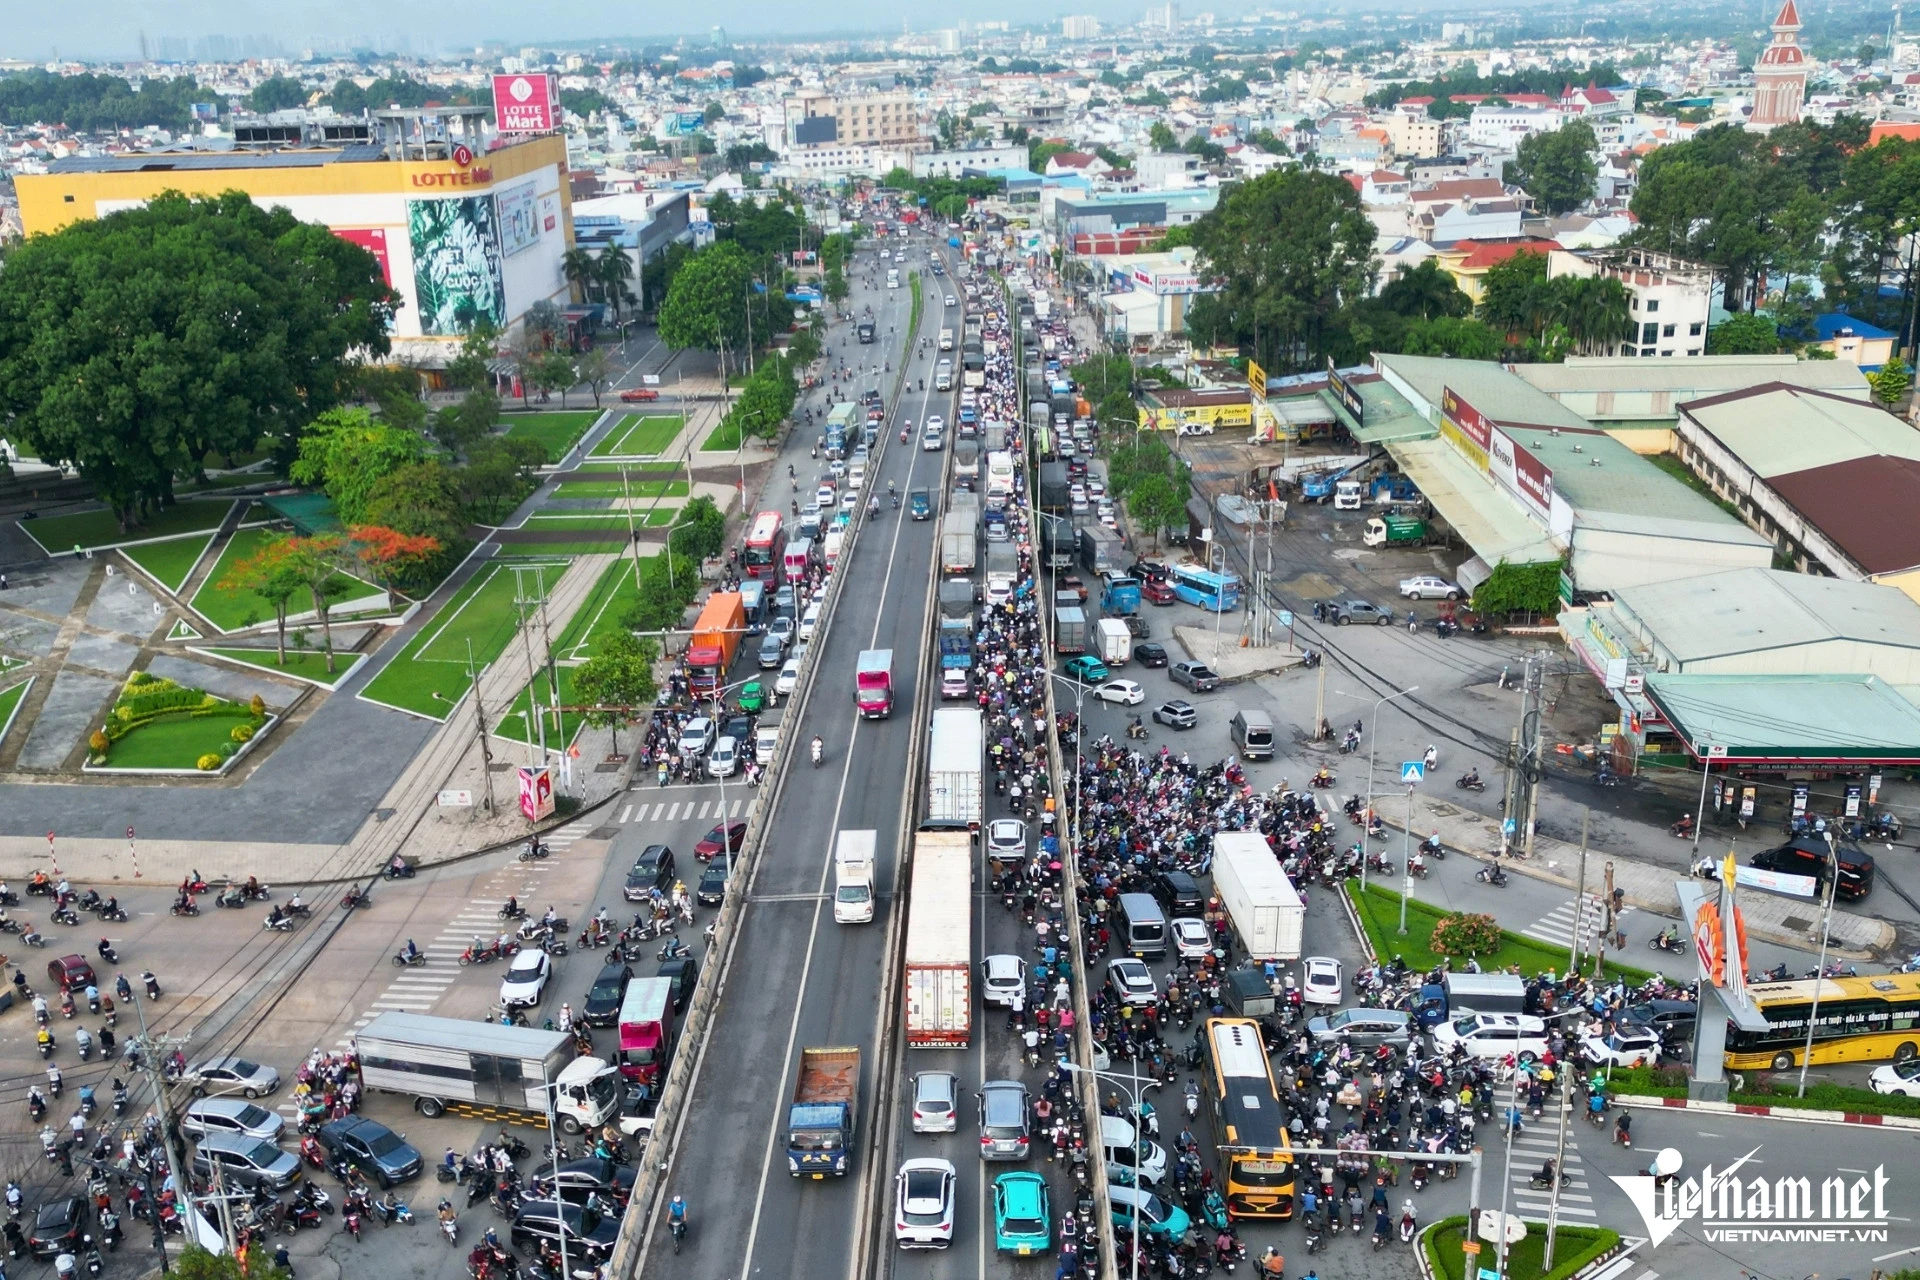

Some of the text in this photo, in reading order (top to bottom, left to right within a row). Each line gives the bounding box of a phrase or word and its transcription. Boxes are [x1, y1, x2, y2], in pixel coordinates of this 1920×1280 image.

[503, 104, 542, 115] LOTTE
[505, 115, 544, 129] Mart
[412, 172, 470, 187] LOTTE
